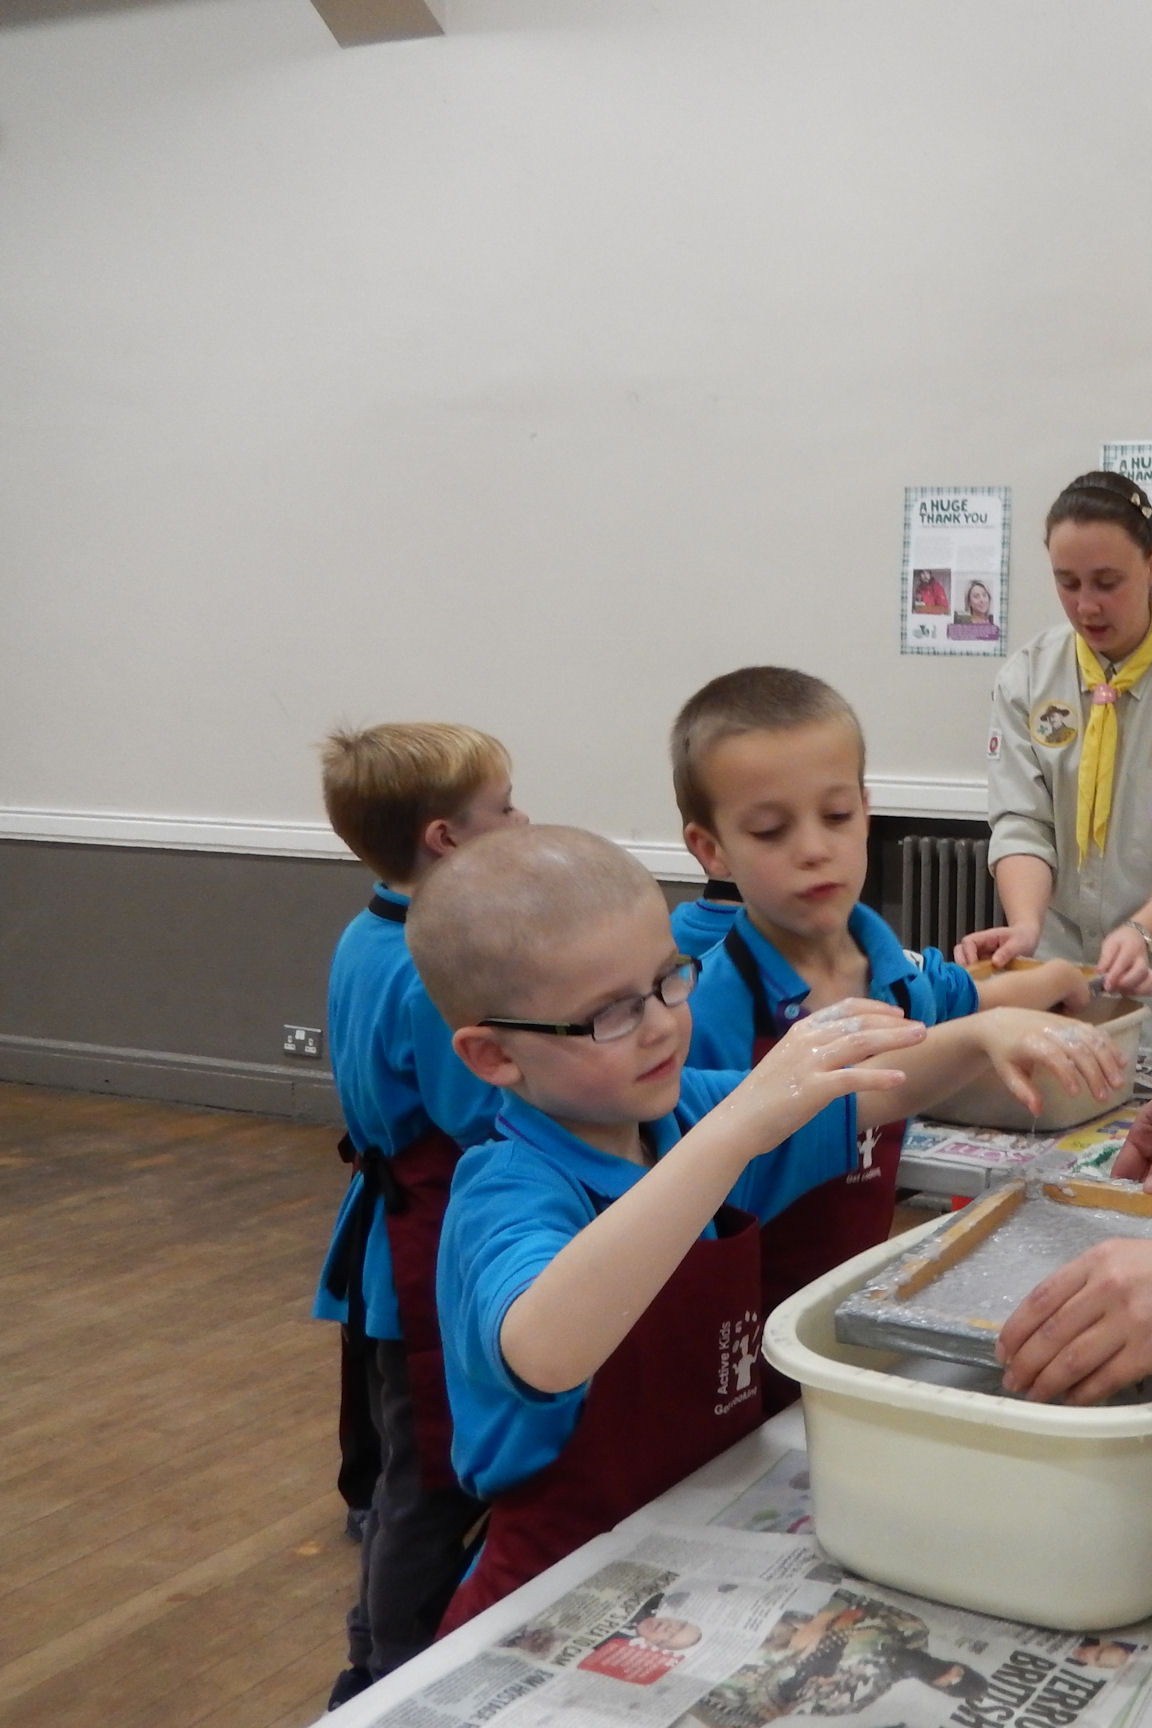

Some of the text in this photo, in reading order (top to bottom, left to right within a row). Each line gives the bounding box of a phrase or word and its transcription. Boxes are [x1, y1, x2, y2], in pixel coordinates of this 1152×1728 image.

[1119, 459, 1128, 472] A
[919, 499, 968, 513] A HUGE
[919, 512, 988, 524] THANK YOU
[717, 1321, 731, 1395] Active Kids
[950, 1650, 1058, 1728] BRITISH
